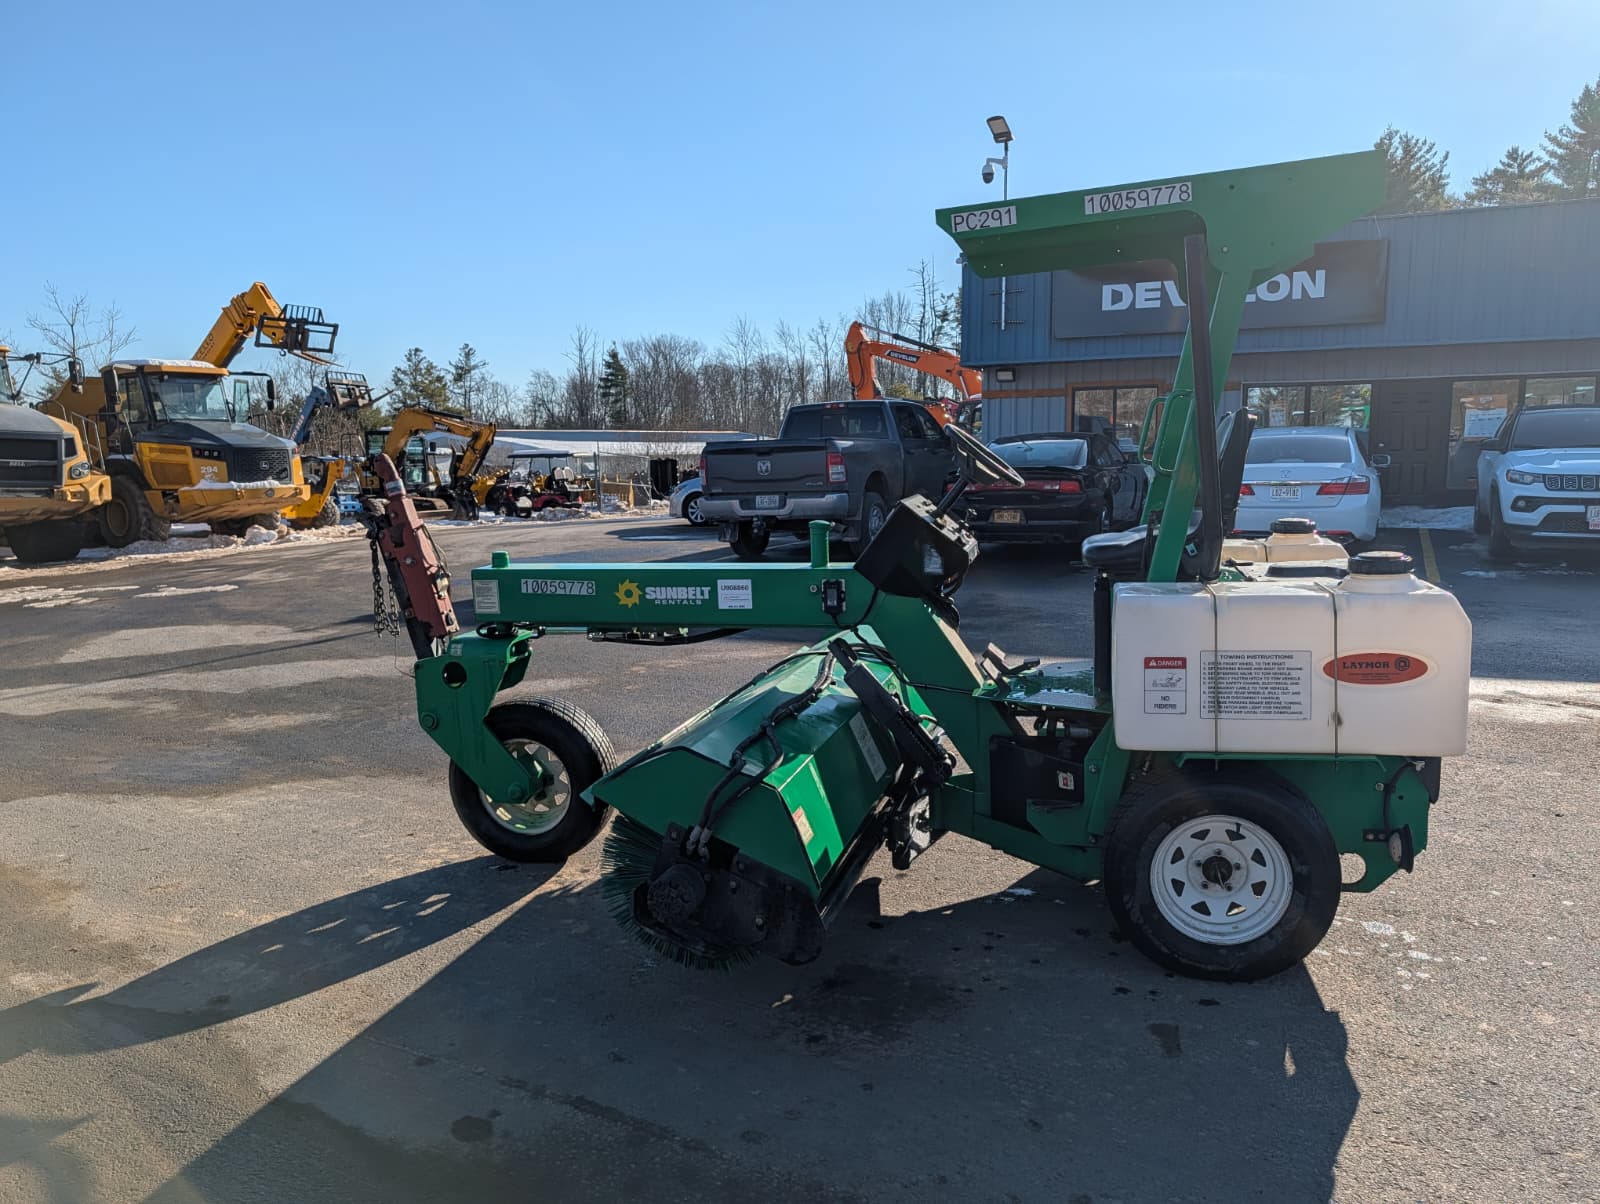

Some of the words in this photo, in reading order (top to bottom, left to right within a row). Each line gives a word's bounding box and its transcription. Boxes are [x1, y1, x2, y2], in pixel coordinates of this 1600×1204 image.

[1087, 184, 1190, 214] 10059778
[953, 208, 1012, 232] PC291
[522, 580, 595, 594] 10059778
[645, 586, 711, 600] SUNBELT
[1343, 661, 1390, 670] LAYMOR
